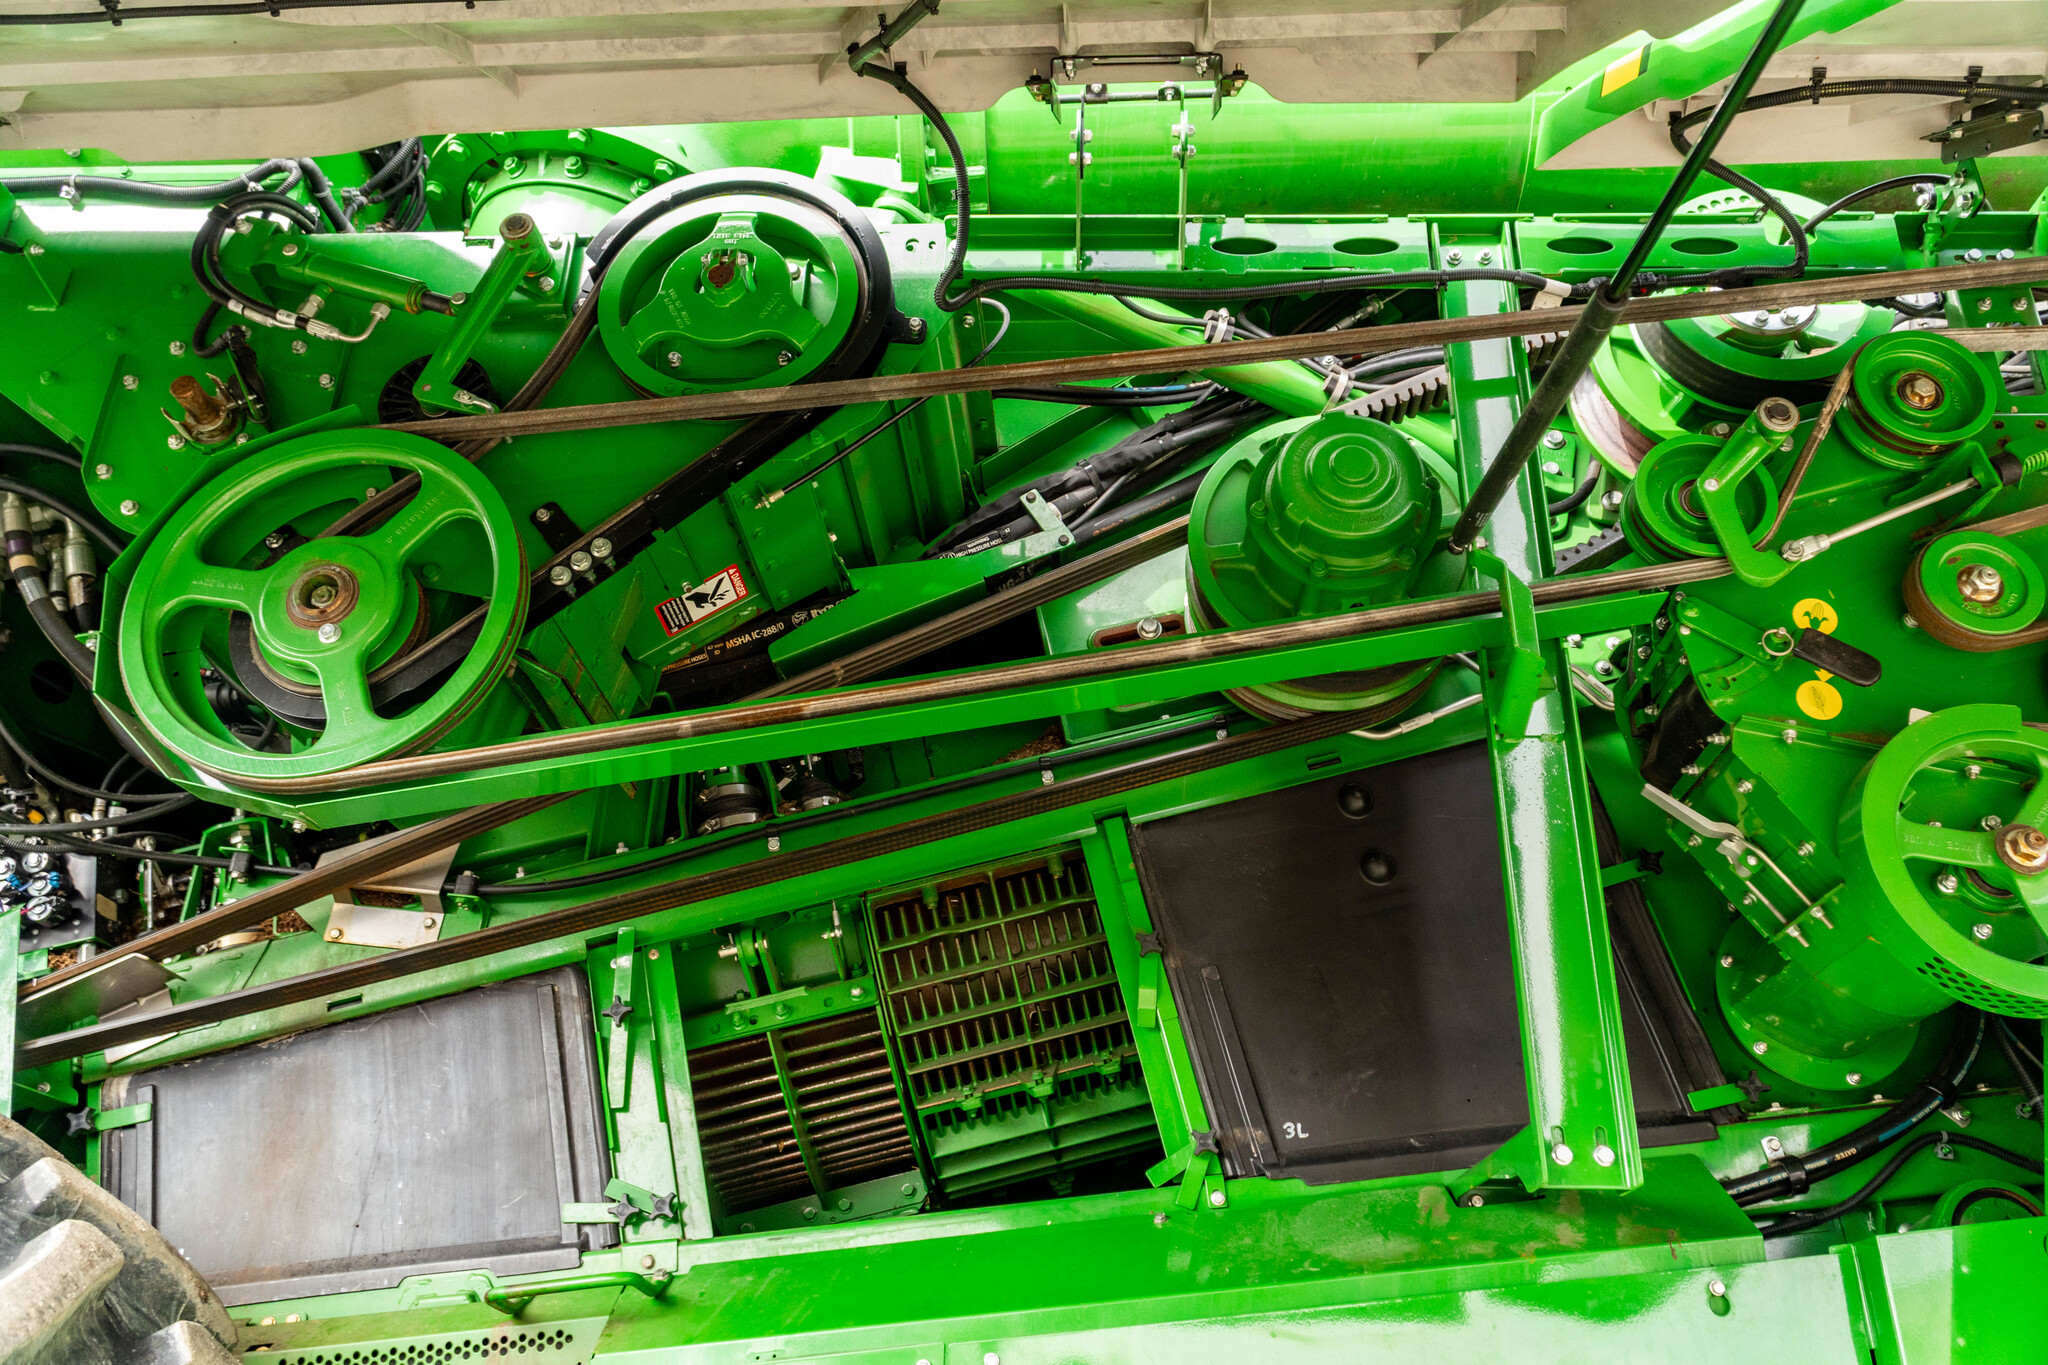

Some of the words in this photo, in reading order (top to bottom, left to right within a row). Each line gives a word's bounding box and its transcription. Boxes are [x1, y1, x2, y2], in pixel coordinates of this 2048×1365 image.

[968, 542, 991, 555] PRESSURE
[731, 573, 747, 598] DANGER
[725, 632, 753, 649] MSHA
[751, 622, 785, 641] IC-288/0
[690, 653, 708, 664] HOSES
[1279, 1117, 1310, 1139] 3L
[1836, 1147, 1857, 1161] GATES
